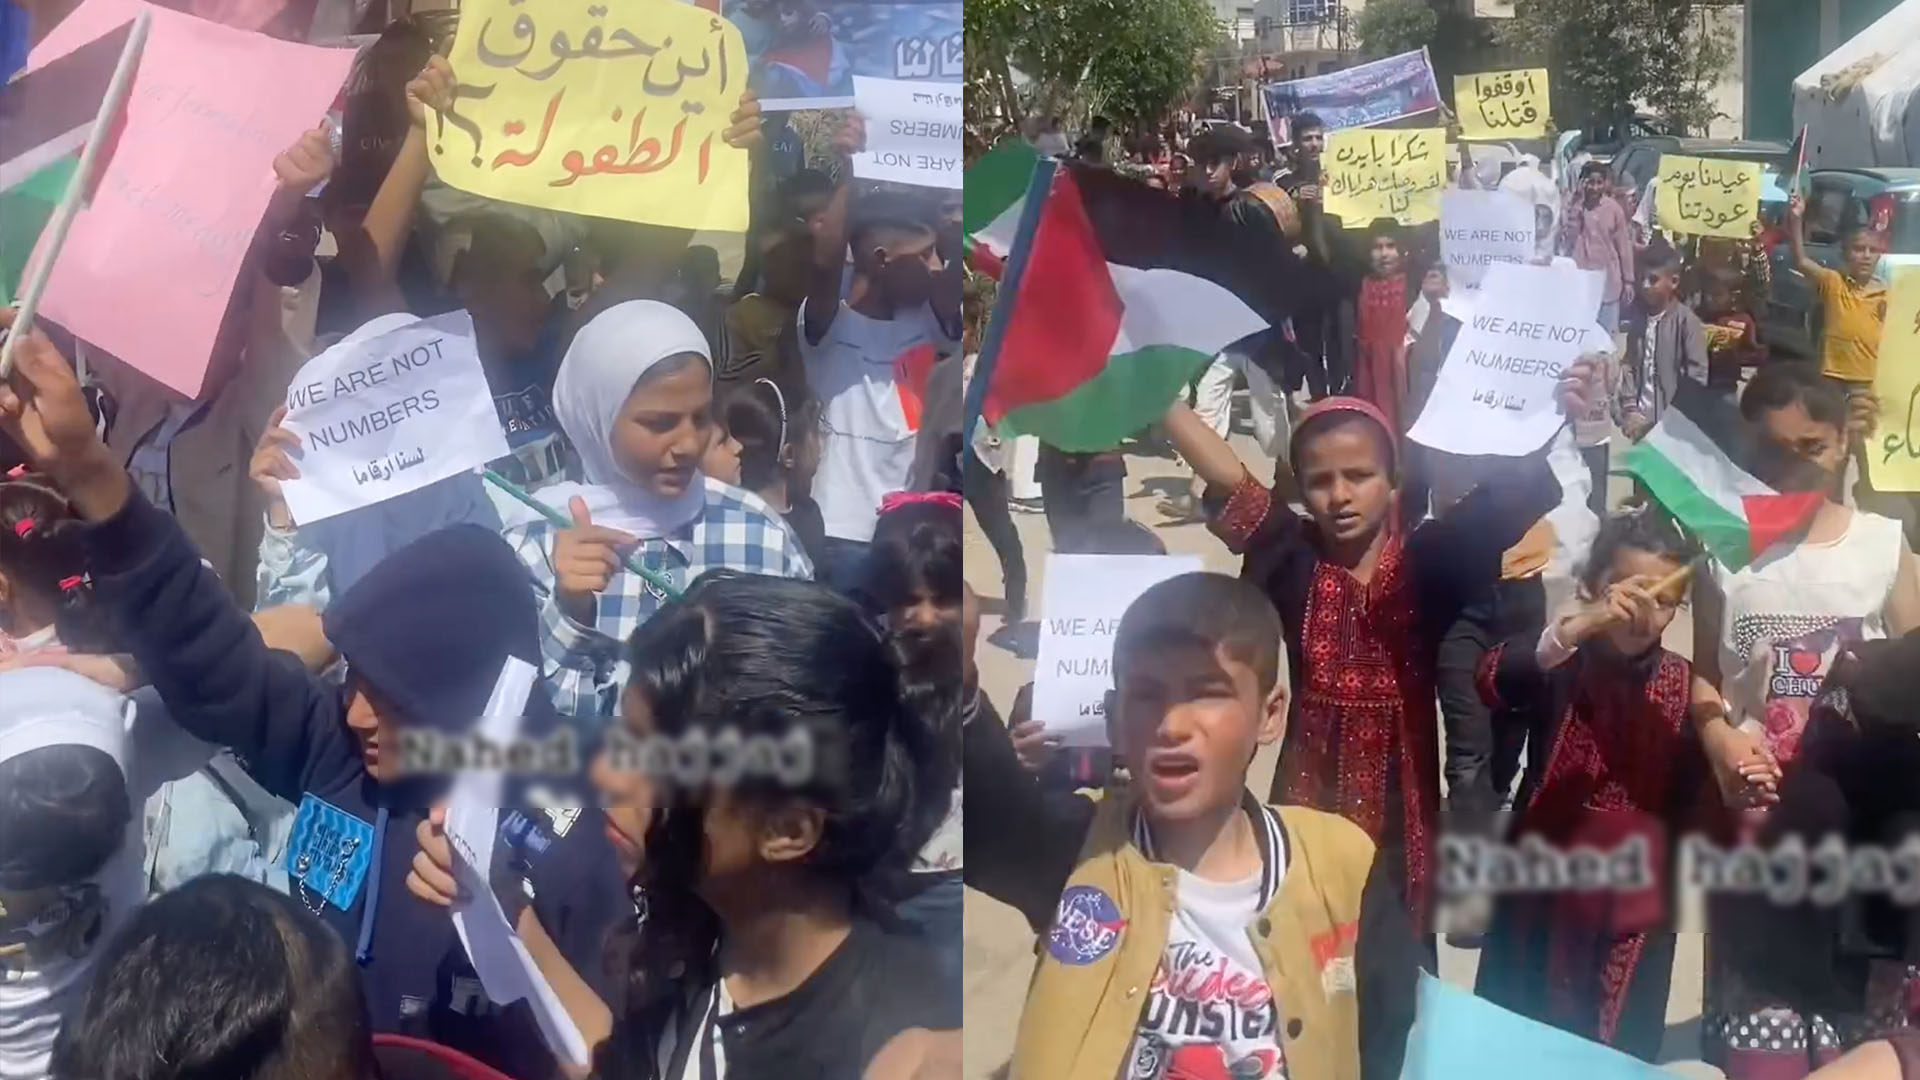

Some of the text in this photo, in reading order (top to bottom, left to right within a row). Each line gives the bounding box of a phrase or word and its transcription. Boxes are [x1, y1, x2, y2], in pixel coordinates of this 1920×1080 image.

[476, 0, 728, 115] أين حقوق
[873, 152, 956, 172] ARE NOT
[1444, 228, 1533, 243] WE ARE NOT
[1472, 312, 1590, 346] WE ARE NOT
[289, 338, 445, 411] WE ARE NOT
[1465, 348, 1562, 379] NUMBERS
[308, 388, 441, 452] NUMBERS
[1050, 617, 1120, 636] WE AR
[1056, 658, 1112, 677] NUM
[1771, 675, 1823, 697] CHU
